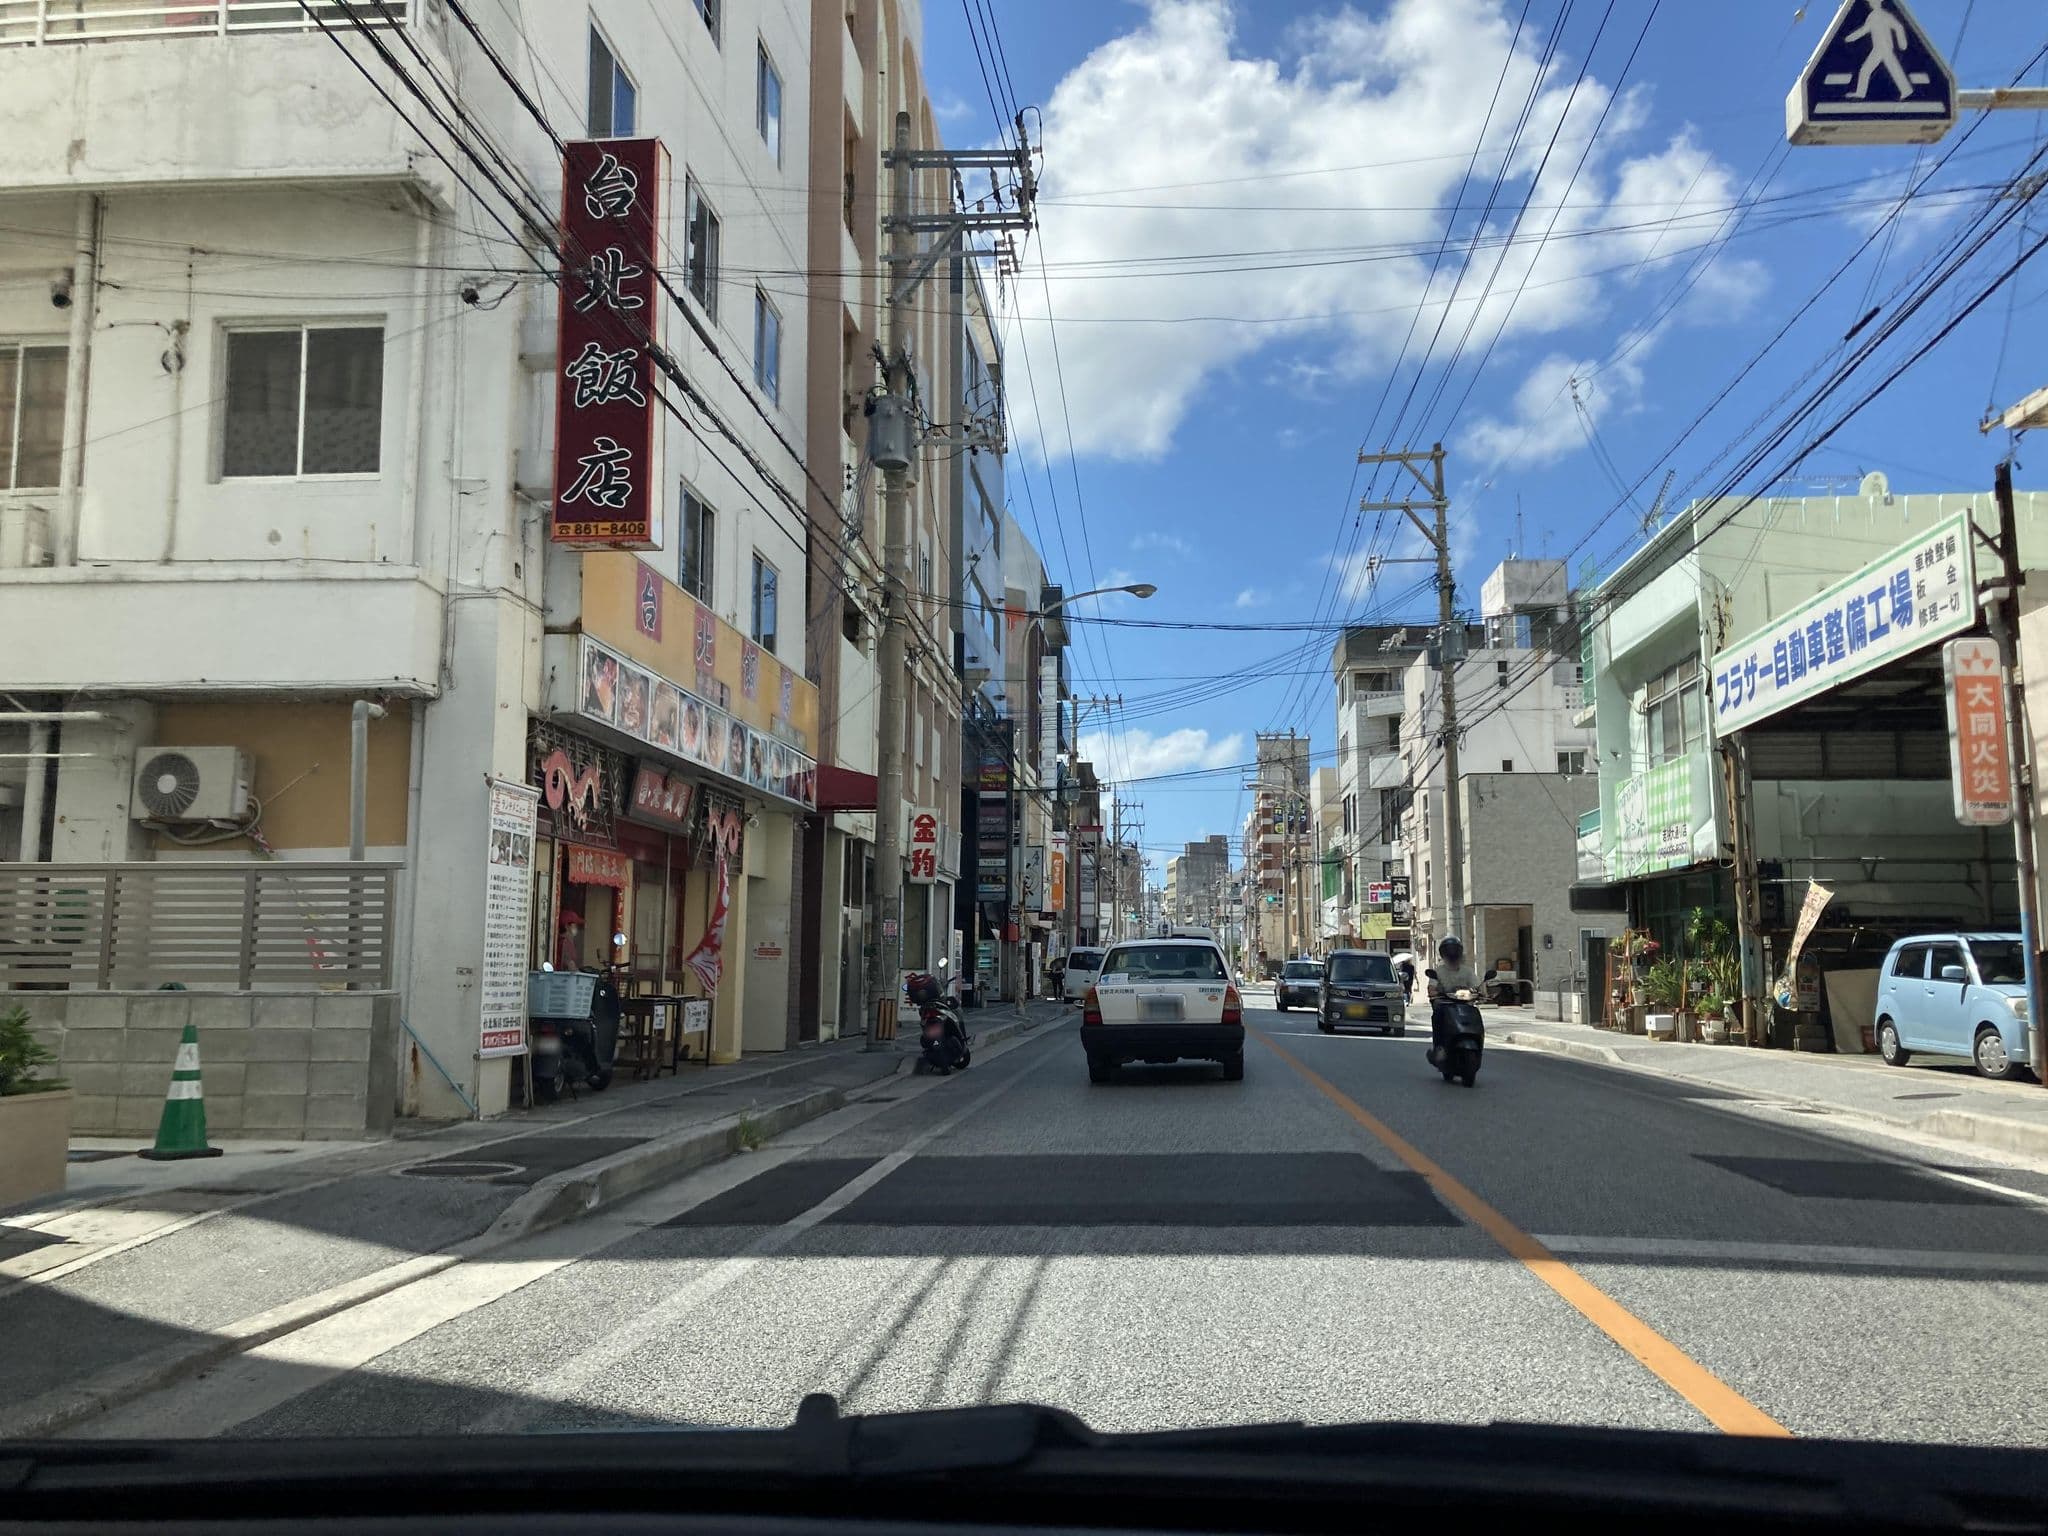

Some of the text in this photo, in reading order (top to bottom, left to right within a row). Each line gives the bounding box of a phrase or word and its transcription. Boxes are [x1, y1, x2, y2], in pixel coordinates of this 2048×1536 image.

[560, 153, 647, 509] 台北飯店
[574, 523, 646, 535] 861-8409
[1915, 535, 1956, 573] 車検整備
[1916, 565, 1958, 600] 板 金
[1918, 591, 1961, 629] 修理一切
[1967, 682, 2001, 795] 大同火災
